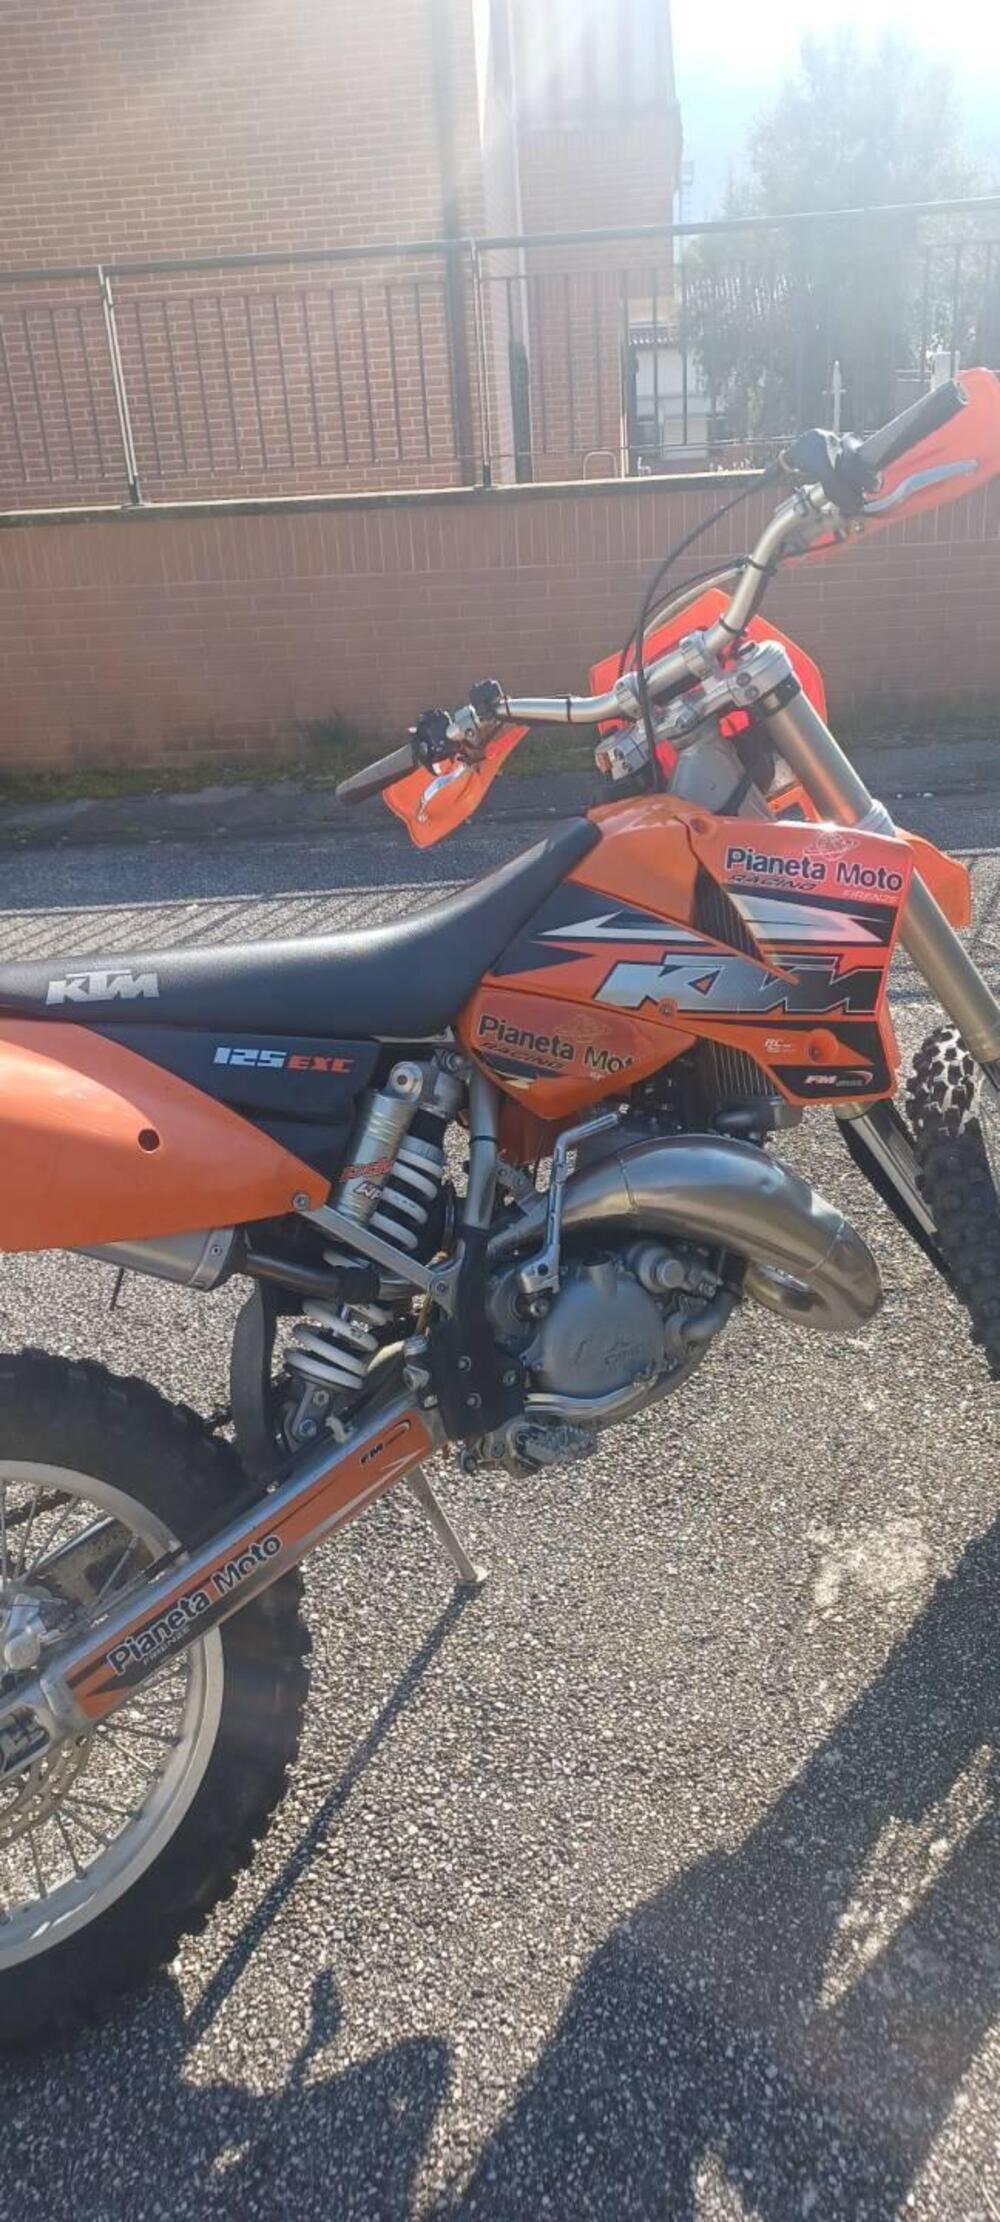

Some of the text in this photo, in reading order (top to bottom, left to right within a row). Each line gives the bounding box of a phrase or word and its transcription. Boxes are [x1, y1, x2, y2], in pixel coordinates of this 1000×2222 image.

[726, 846, 904, 892] Pianeta Moto
[728, 873, 818, 891] RACING
[46, 969, 160, 1005] KTM
[592, 953, 886, 1014] KTM
[478, 1014, 575, 1061] Pianeta
[479, 1041, 566, 1071] RACING
[213, 1047, 355, 1074] 125 EXC
[106, 1534, 283, 1677] Pianeta Moto
